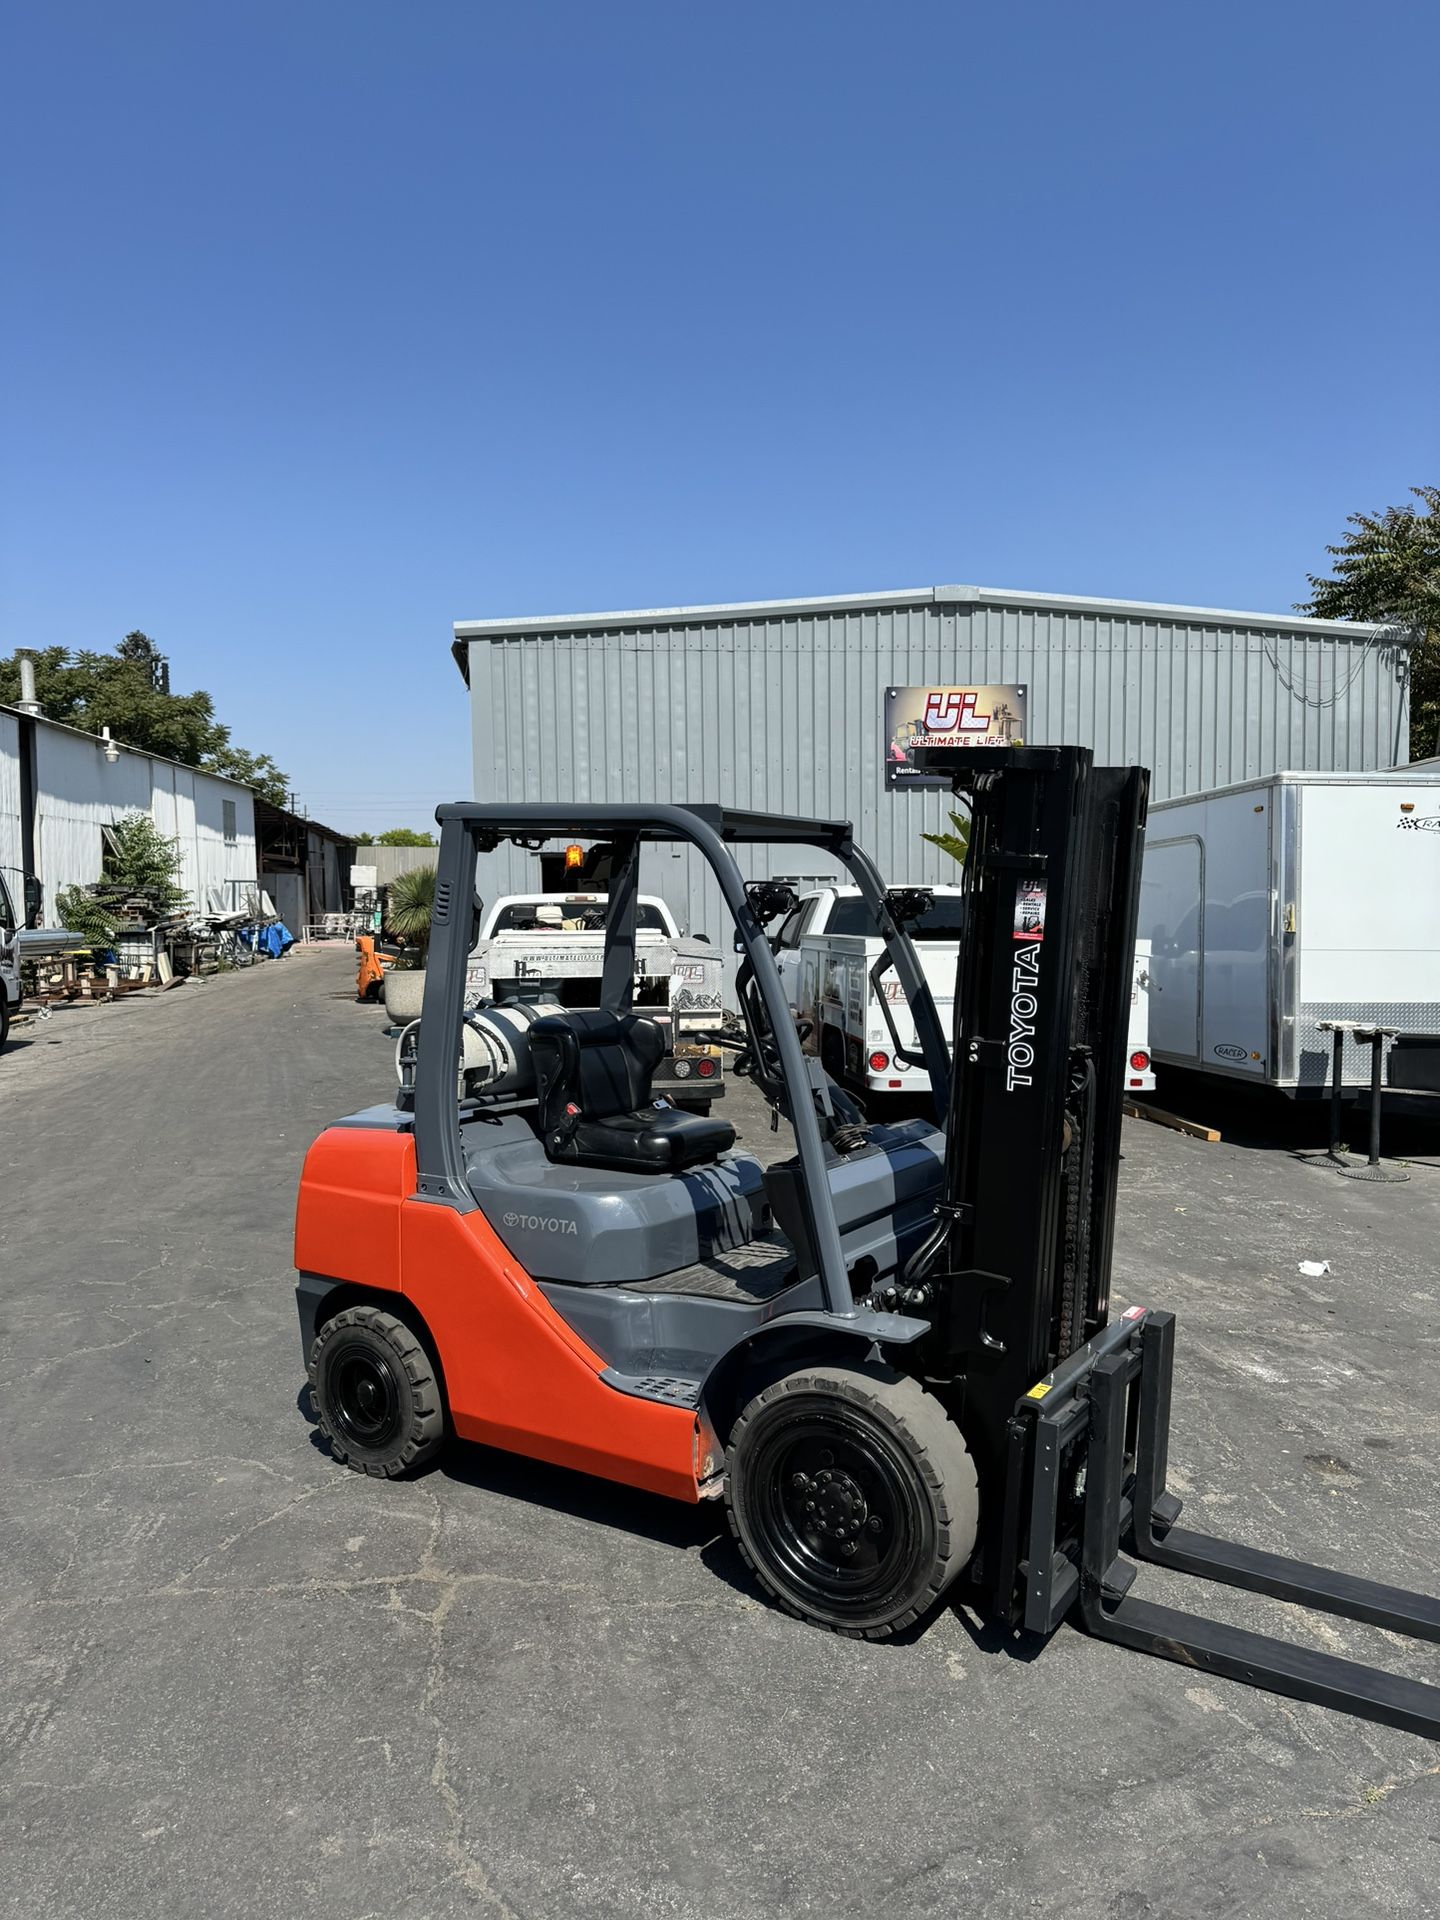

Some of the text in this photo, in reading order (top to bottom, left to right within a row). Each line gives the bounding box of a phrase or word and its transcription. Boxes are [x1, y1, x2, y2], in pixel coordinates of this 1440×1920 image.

[924, 692, 991, 731] UL
[911, 736, 1005, 746] ULTIMATE LIFT
[1007, 943, 1041, 1092] TOYOTA
[1218, 1047, 1243, 1057] RACER
[519, 1214, 578, 1235] TOYOTA
